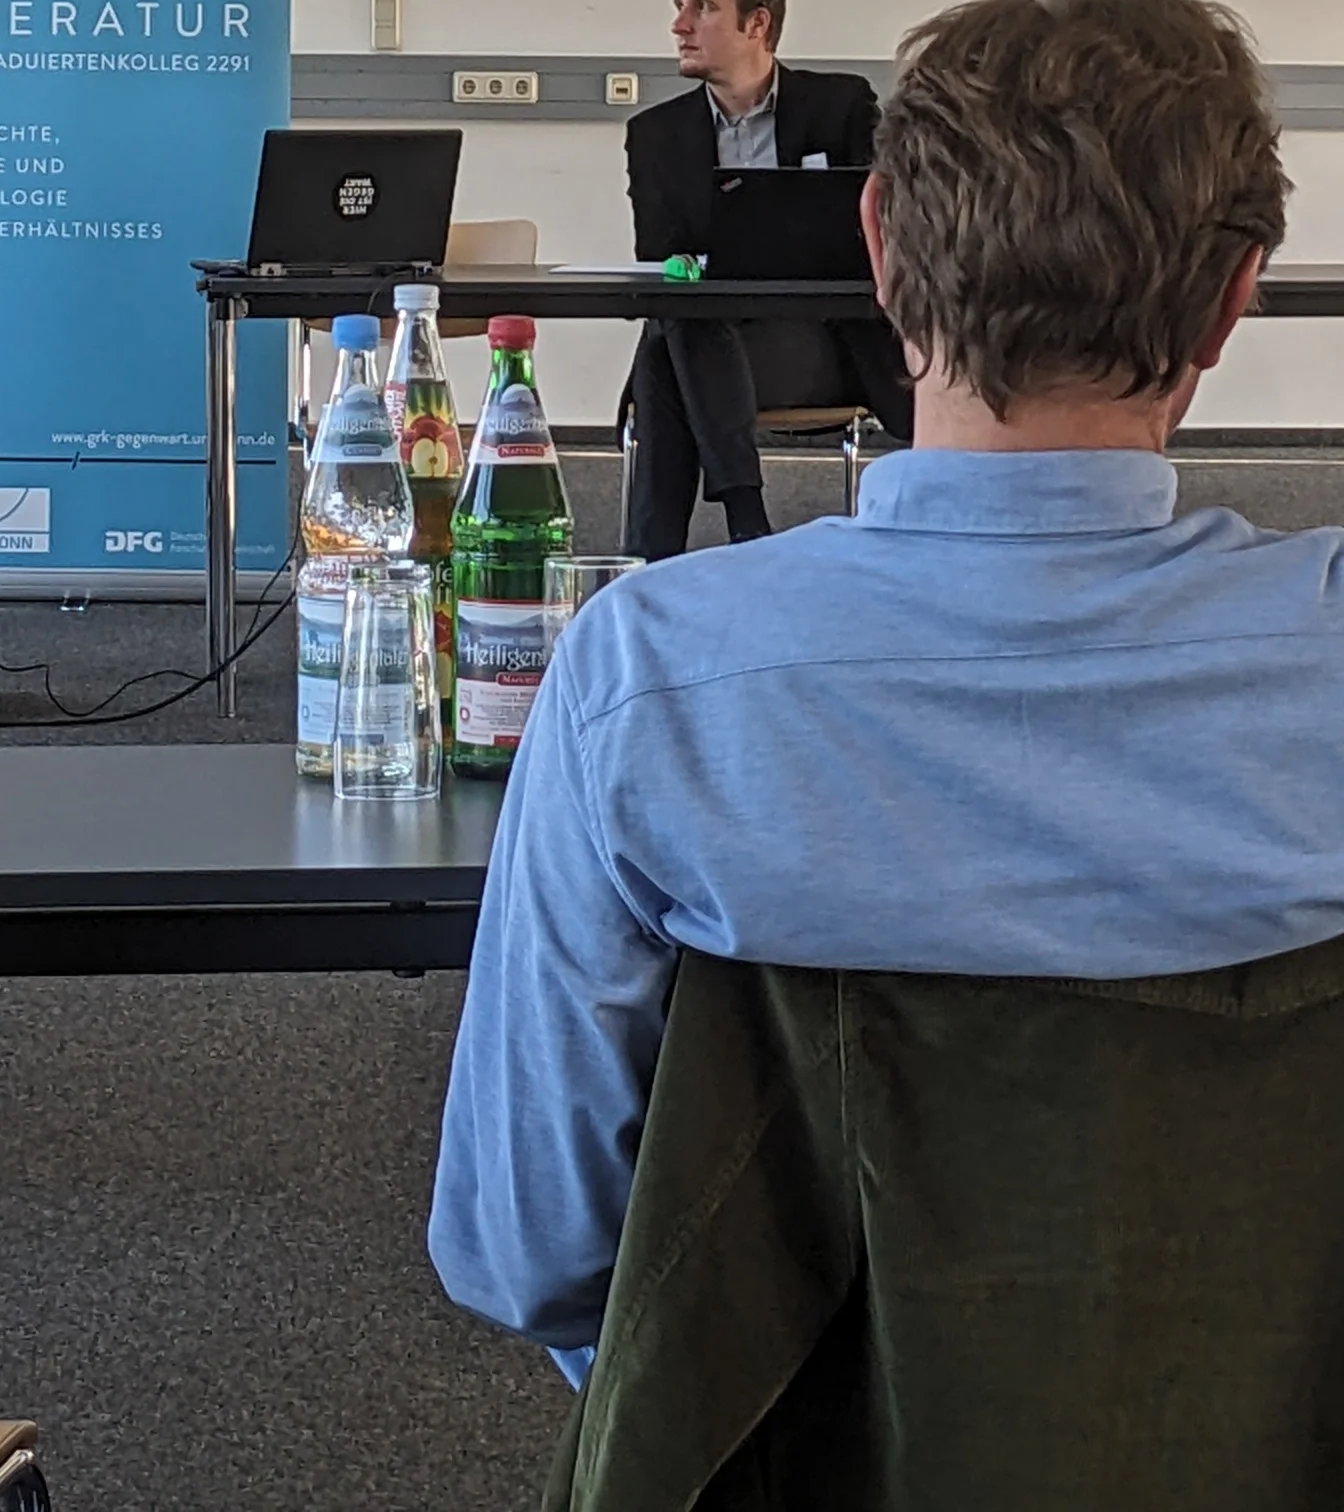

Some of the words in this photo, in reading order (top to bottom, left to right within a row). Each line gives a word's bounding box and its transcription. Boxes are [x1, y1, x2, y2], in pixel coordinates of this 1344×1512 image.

[206, 54, 251, 73] 2291
[15, 158, 65, 174] UND
[105, 530, 164, 553] DFG
